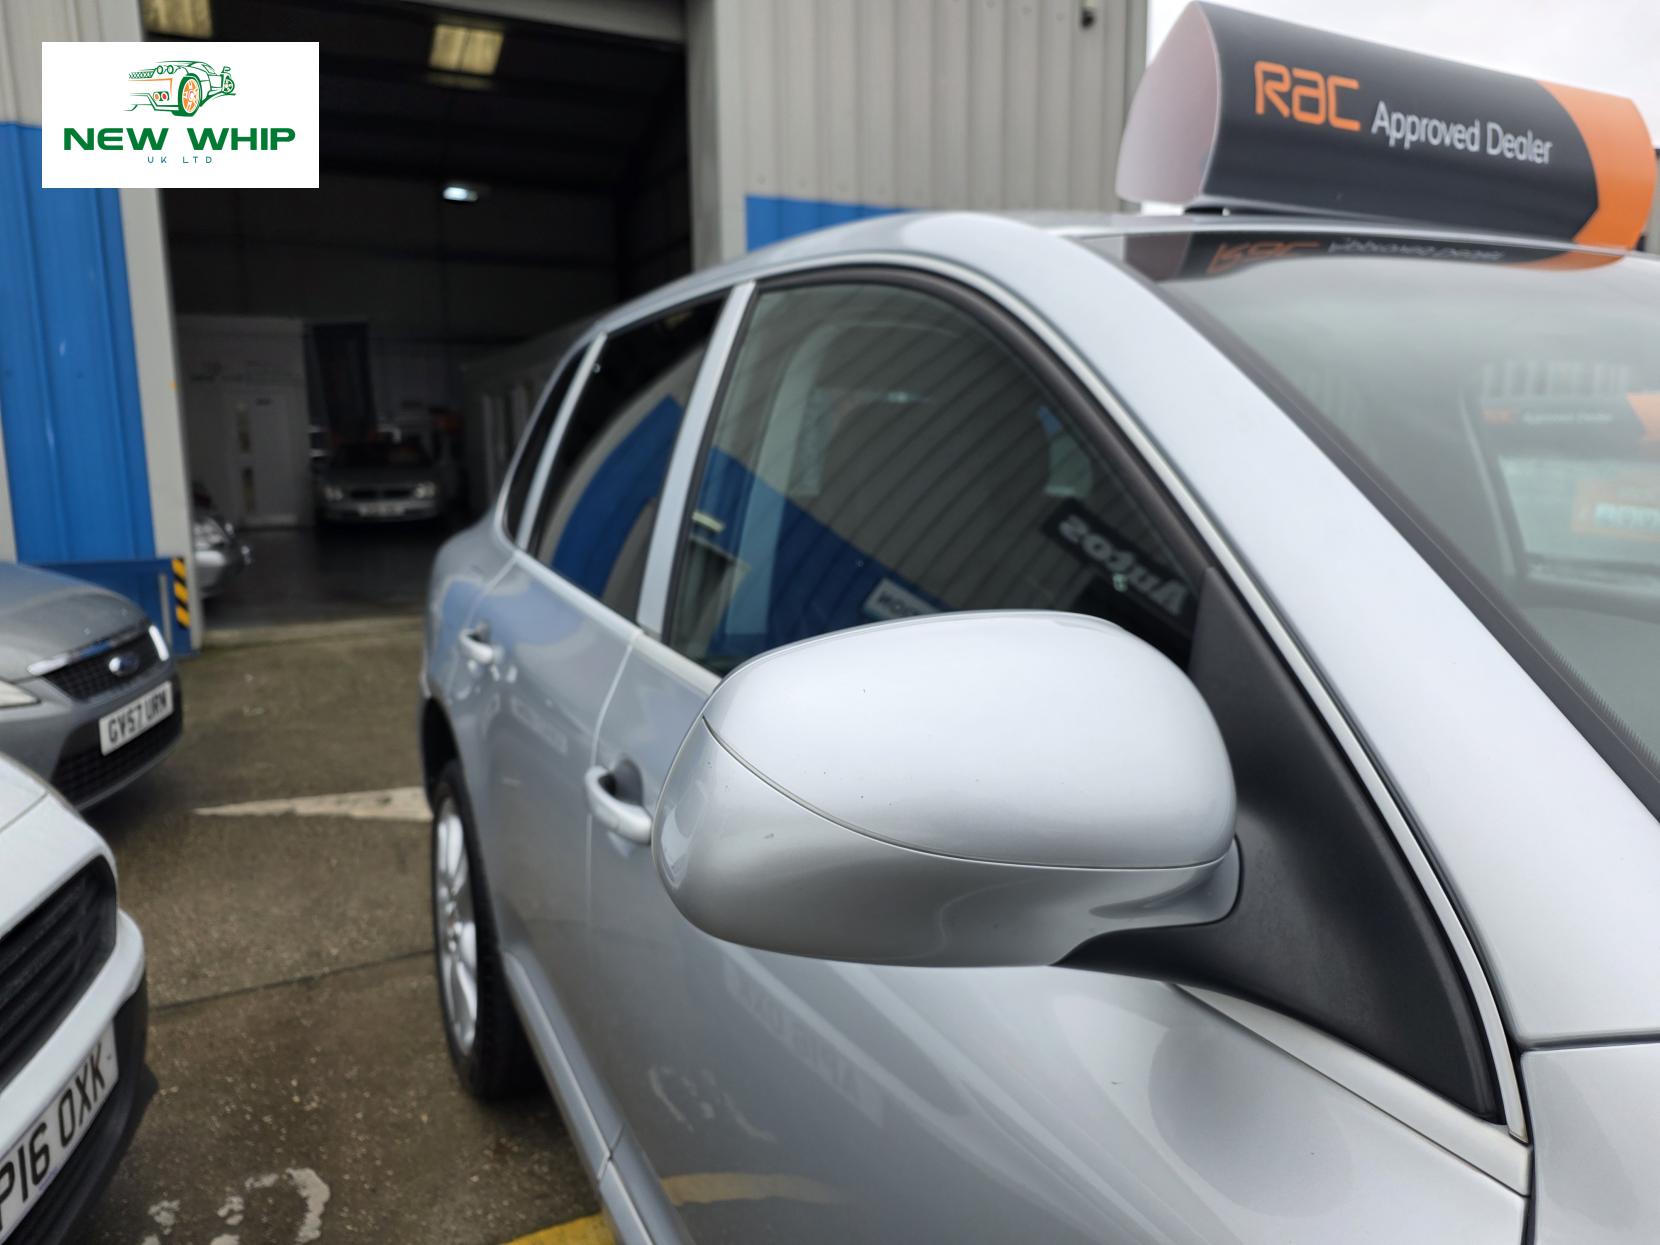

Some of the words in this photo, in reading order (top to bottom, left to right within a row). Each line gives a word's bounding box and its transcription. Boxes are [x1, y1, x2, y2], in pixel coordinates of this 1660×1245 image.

[1371, 100, 1481, 152] Approved
[1486, 121, 1553, 164] Dealer
[58, 1041, 105, 1148] OXK
